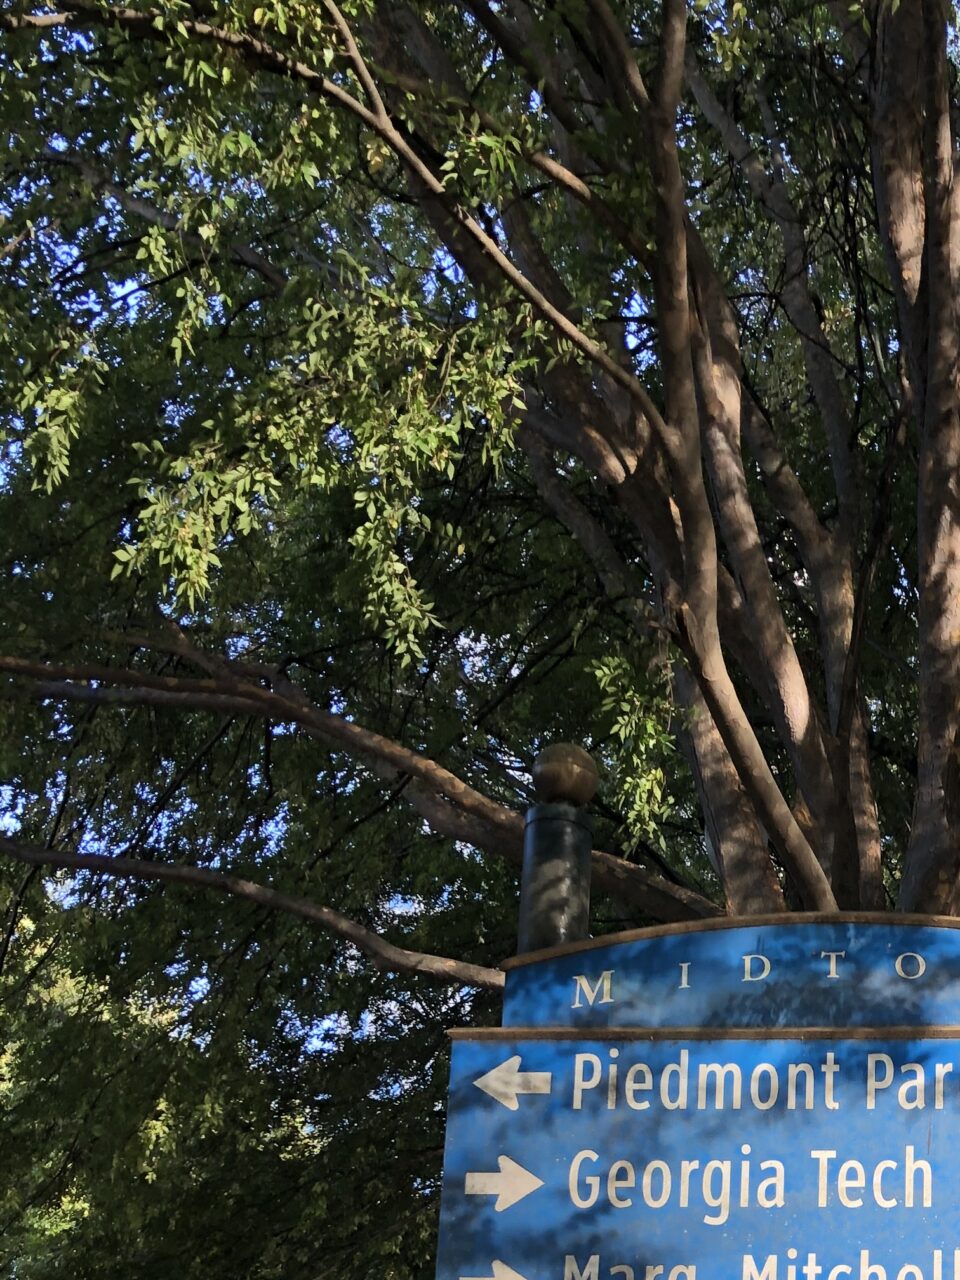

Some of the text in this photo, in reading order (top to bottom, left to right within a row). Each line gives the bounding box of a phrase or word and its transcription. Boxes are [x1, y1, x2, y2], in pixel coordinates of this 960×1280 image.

[572, 1048, 841, 1111] Piedmont
[568, 1143, 935, 1226] Georgia Tech
